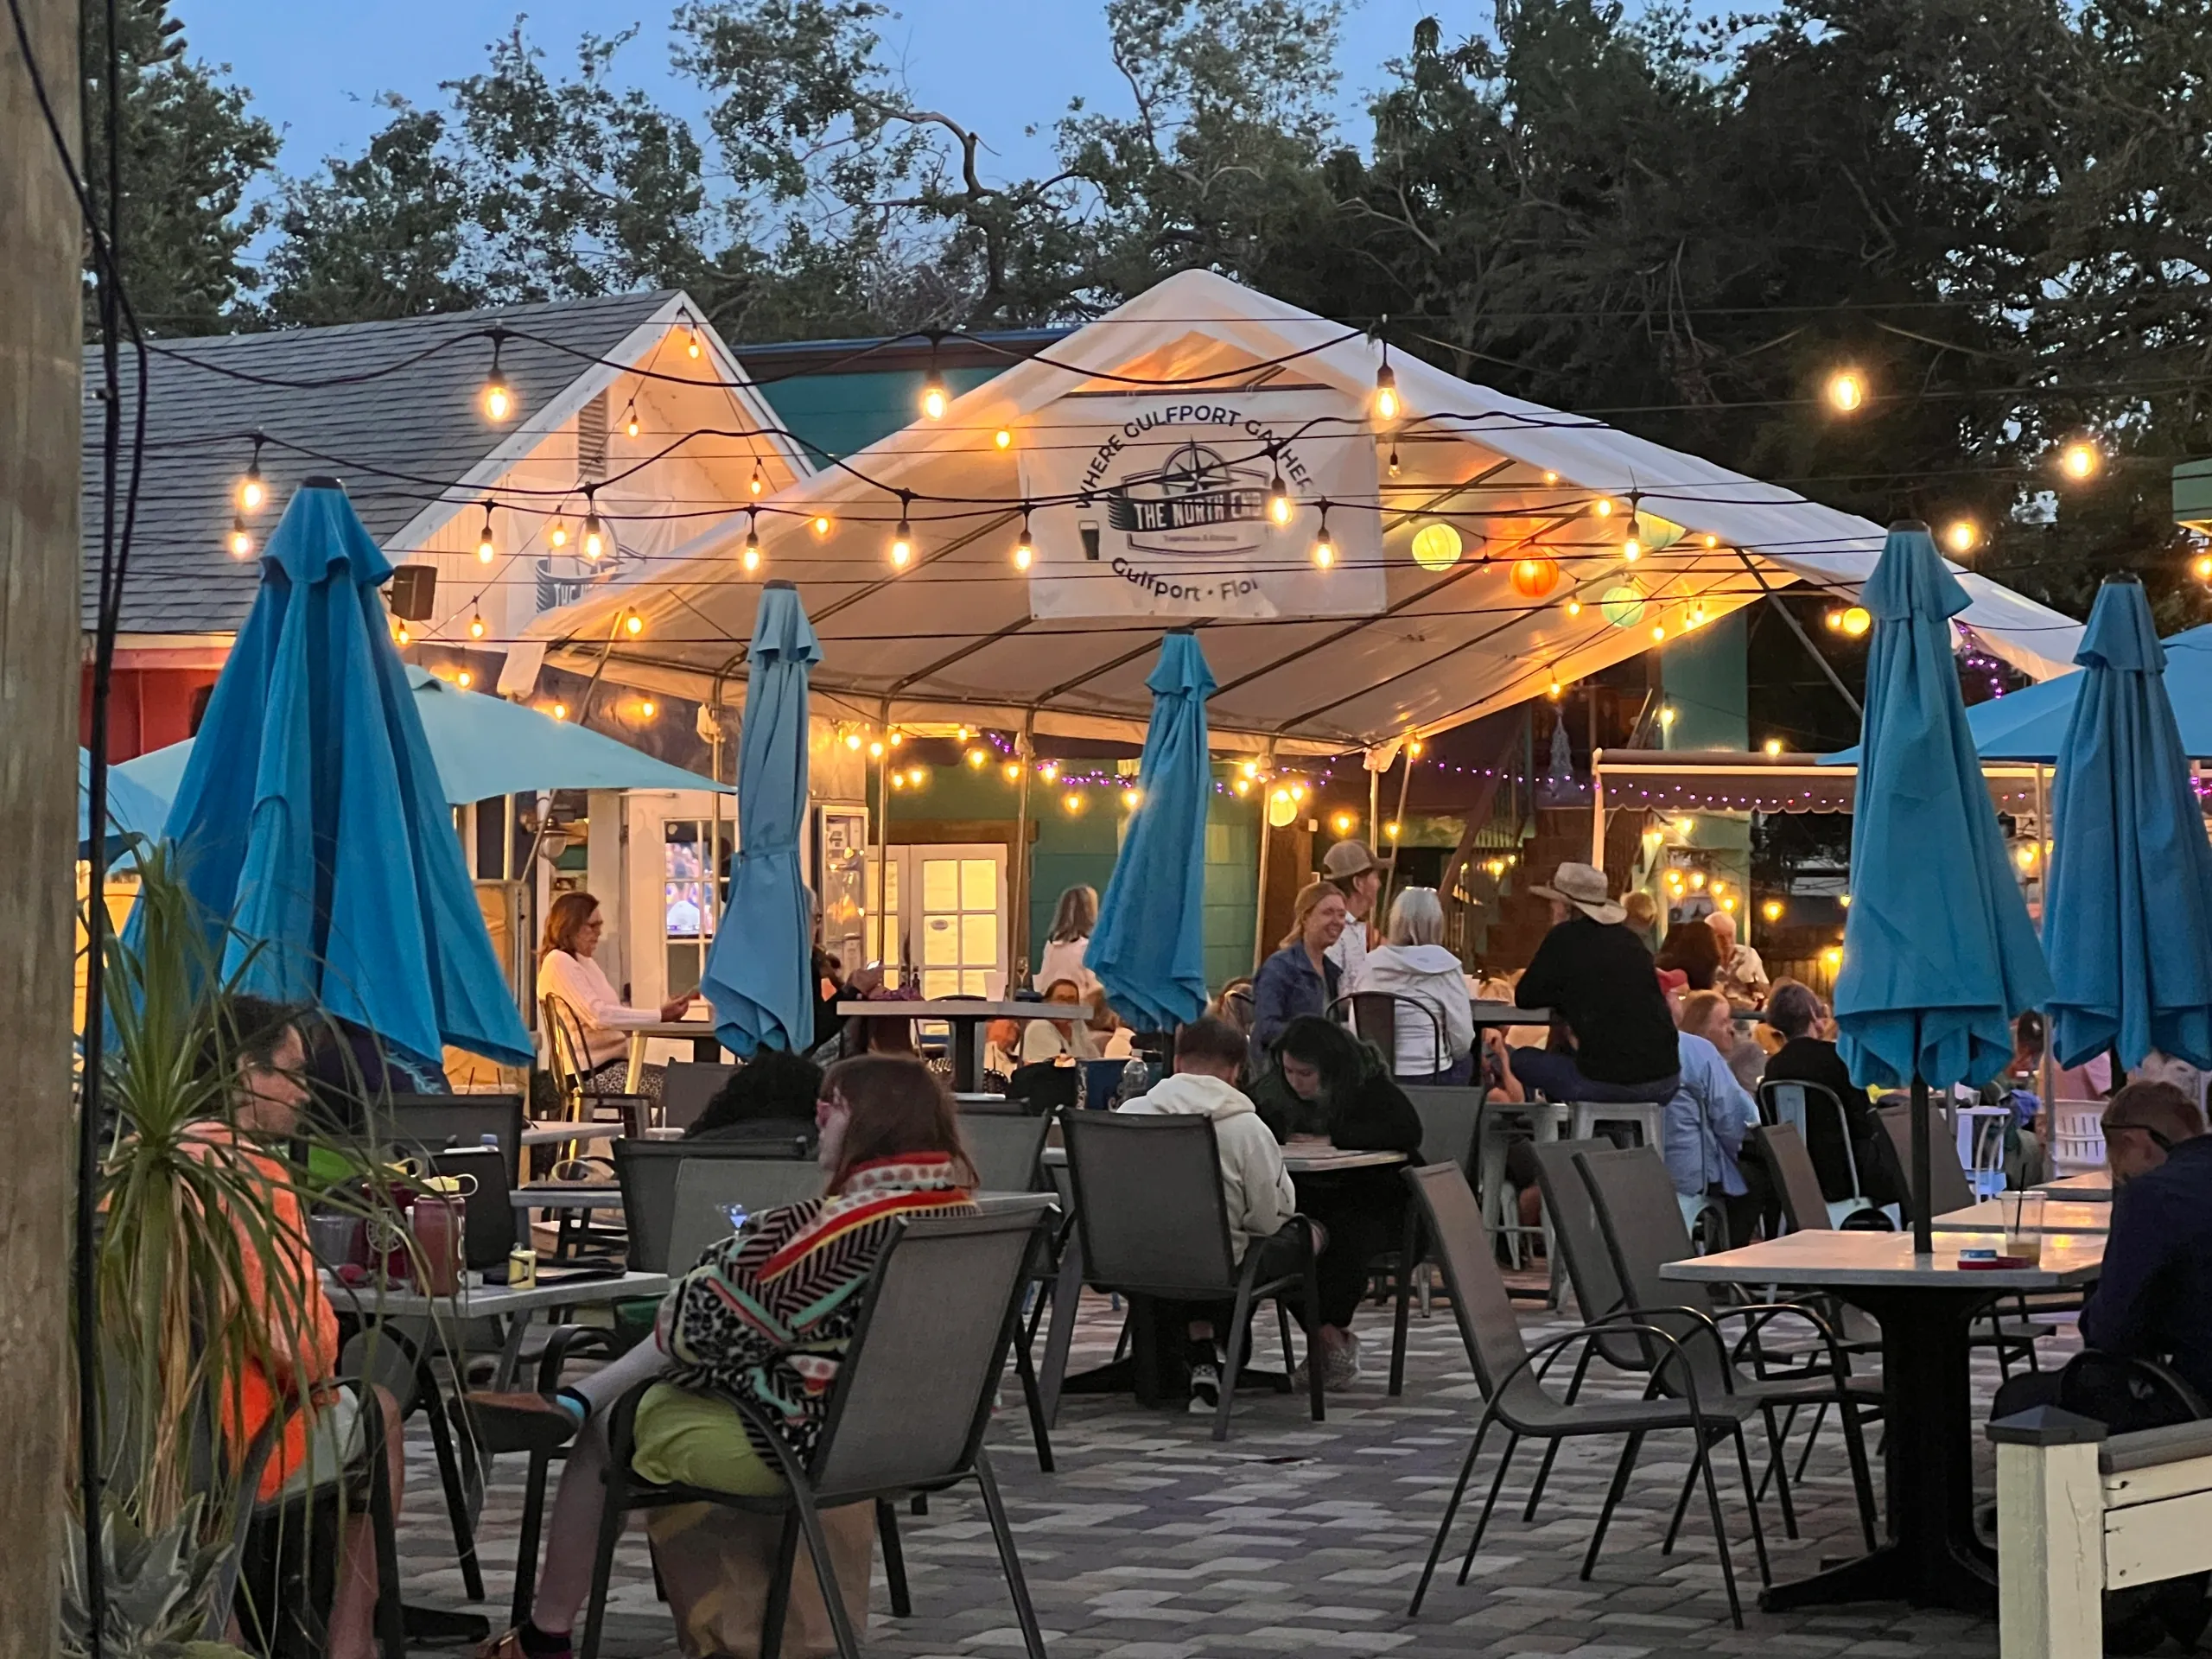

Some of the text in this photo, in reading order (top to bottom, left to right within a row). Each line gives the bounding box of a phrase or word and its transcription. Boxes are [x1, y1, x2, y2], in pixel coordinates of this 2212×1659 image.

[1123, 405, 1241, 438] GULFPORT
[1245, 419, 1313, 493] GAHE
[1134, 502, 1166, 530] THE
[1172, 494, 1224, 527] NORTH
